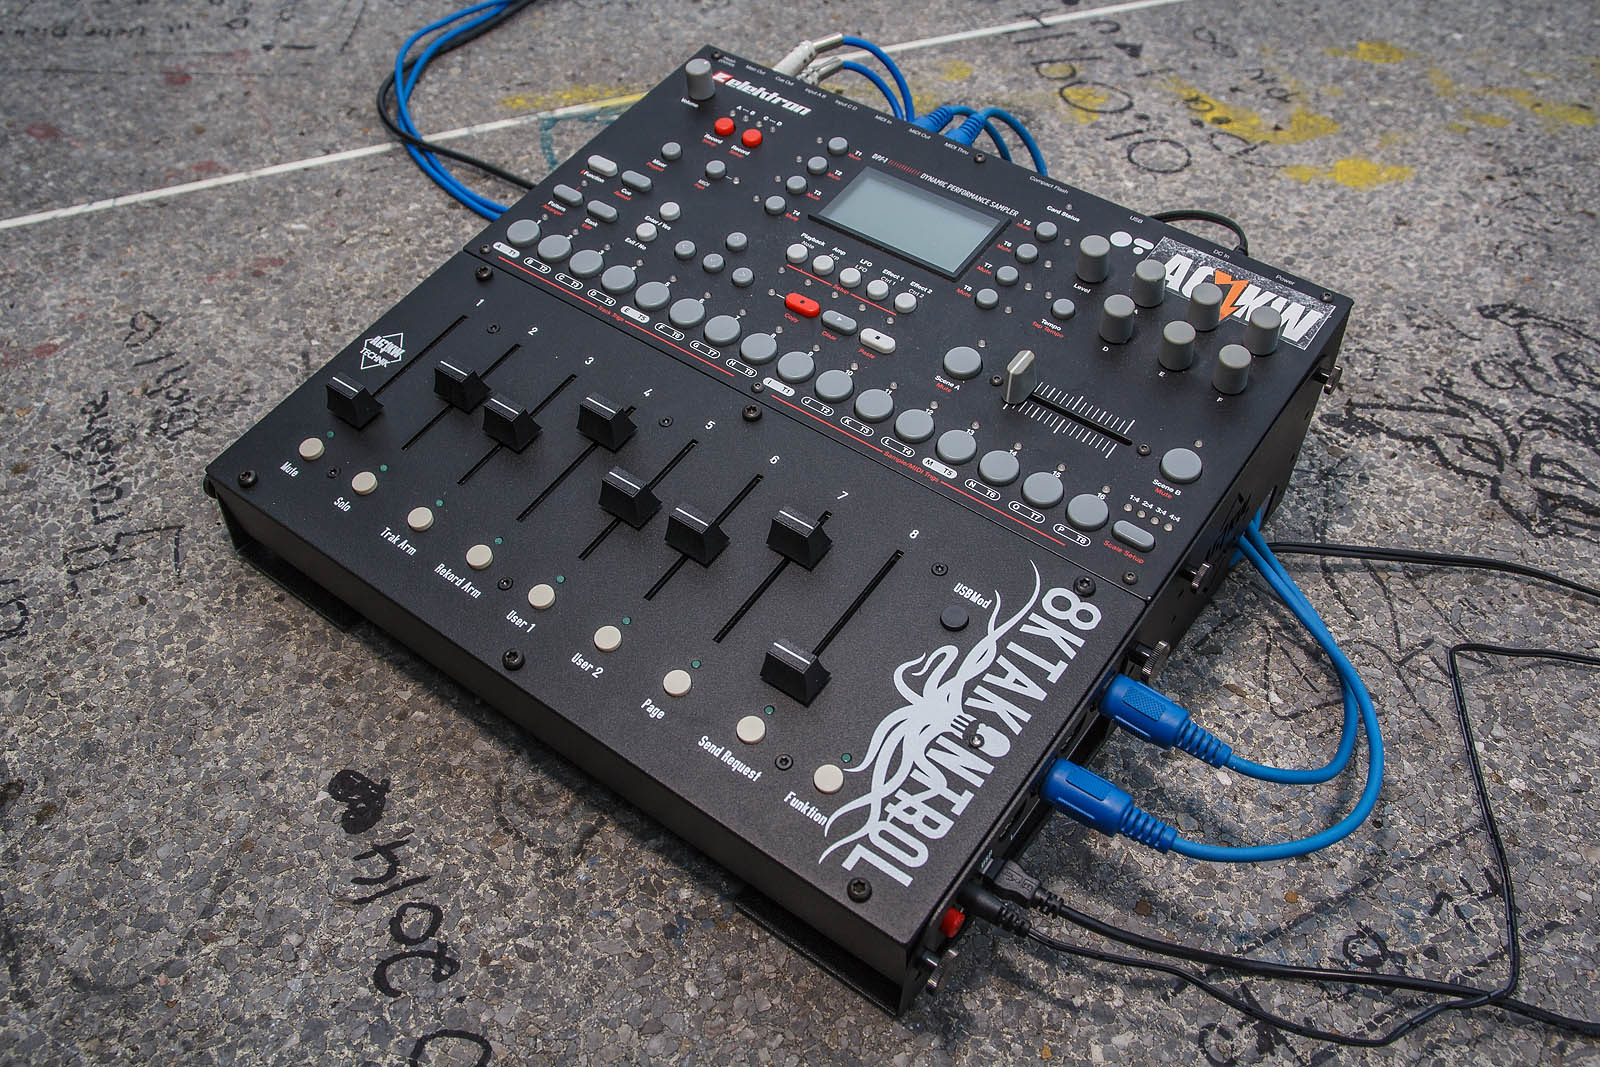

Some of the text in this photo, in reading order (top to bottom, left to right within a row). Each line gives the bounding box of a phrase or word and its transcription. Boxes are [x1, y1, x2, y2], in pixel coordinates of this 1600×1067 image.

[725, 78, 812, 116] elektron
[908, 128, 921, 136] MIDI
[731, 144, 750, 156] Record
[944, 142, 957, 150] MIDI
[1030, 175, 1069, 195] Compact Flash
[920, 172, 948, 190] DYNAMIC
[946, 183, 991, 206] PERFORMANCE
[989, 200, 1020, 217] SAMPLER
[1046, 204, 1081, 223] Card Status
[1129, 215, 1144, 224] USB
[800, 232, 826, 247] Playback
[832, 246, 847, 256] Amp
[860, 258, 873, 268] LFO
[854, 264, 868, 273] LFO
[882, 268, 900, 280] Effect
[880, 276, 892, 285] Ctrl
[1275, 274, 1296, 287] Power
[910, 280, 927, 292] Effect
[1073, 282, 1091, 294] Level
[908, 288, 920, 297] Ctrl
[476, 298, 485, 307] 1
[637, 314, 646, 322] T5
[784, 312, 800, 324] Copy
[1041, 318, 1062, 332] Tempo
[528, 326, 538, 336] 2
[672, 331, 681, 339] T6
[708, 348, 717, 356] T7
[858, 348, 876, 360] Paste
[360, 347, 388, 368] TECHNIK
[584, 356, 595, 365] 3
[744, 367, 754, 376] T8
[934, 374, 961, 392] Scene A
[936, 382, 952, 393] Mute
[643, 388, 654, 397] 4
[782, 386, 791, 394] T1
[884, 388, 893, 396] 11
[820, 406, 830, 414] T2
[704, 420, 716, 430] 5
[860, 425, 870, 434] T3
[966, 428, 975, 436] 13
[902, 446, 912, 456] T4
[1009, 449, 1018, 458] 14
[769, 456, 780, 465] 6
[280, 460, 299, 478] Mute
[943, 468, 954, 476] T5
[1052, 470, 1062, 479] 15
[1152, 478, 1182, 496] Scene B
[836, 490, 849, 500] 7
[986, 489, 996, 498] T6
[1096, 492, 1107, 500] 16
[1154, 487, 1173, 500] Mute
[333, 496, 351, 513] Solo
[1130, 494, 1181, 522] 1:4 2:4 3:4 4:4
[1030, 510, 1042, 520] T7
[909, 529, 920, 540] 8
[1076, 534, 1087, 544] T8
[380, 526, 418, 557] Trak Arm
[1103, 539, 1144, 564] Scale Setup
[434, 562, 482, 600] Rekord Arm
[953, 582, 992, 609] USBMod
[506, 609, 536, 634] User 1
[571, 652, 604, 680] User 2
[640, 698, 666, 720] Page
[698, 735, 763, 783] Send Request
[783, 790, 828, 827] Funktion
